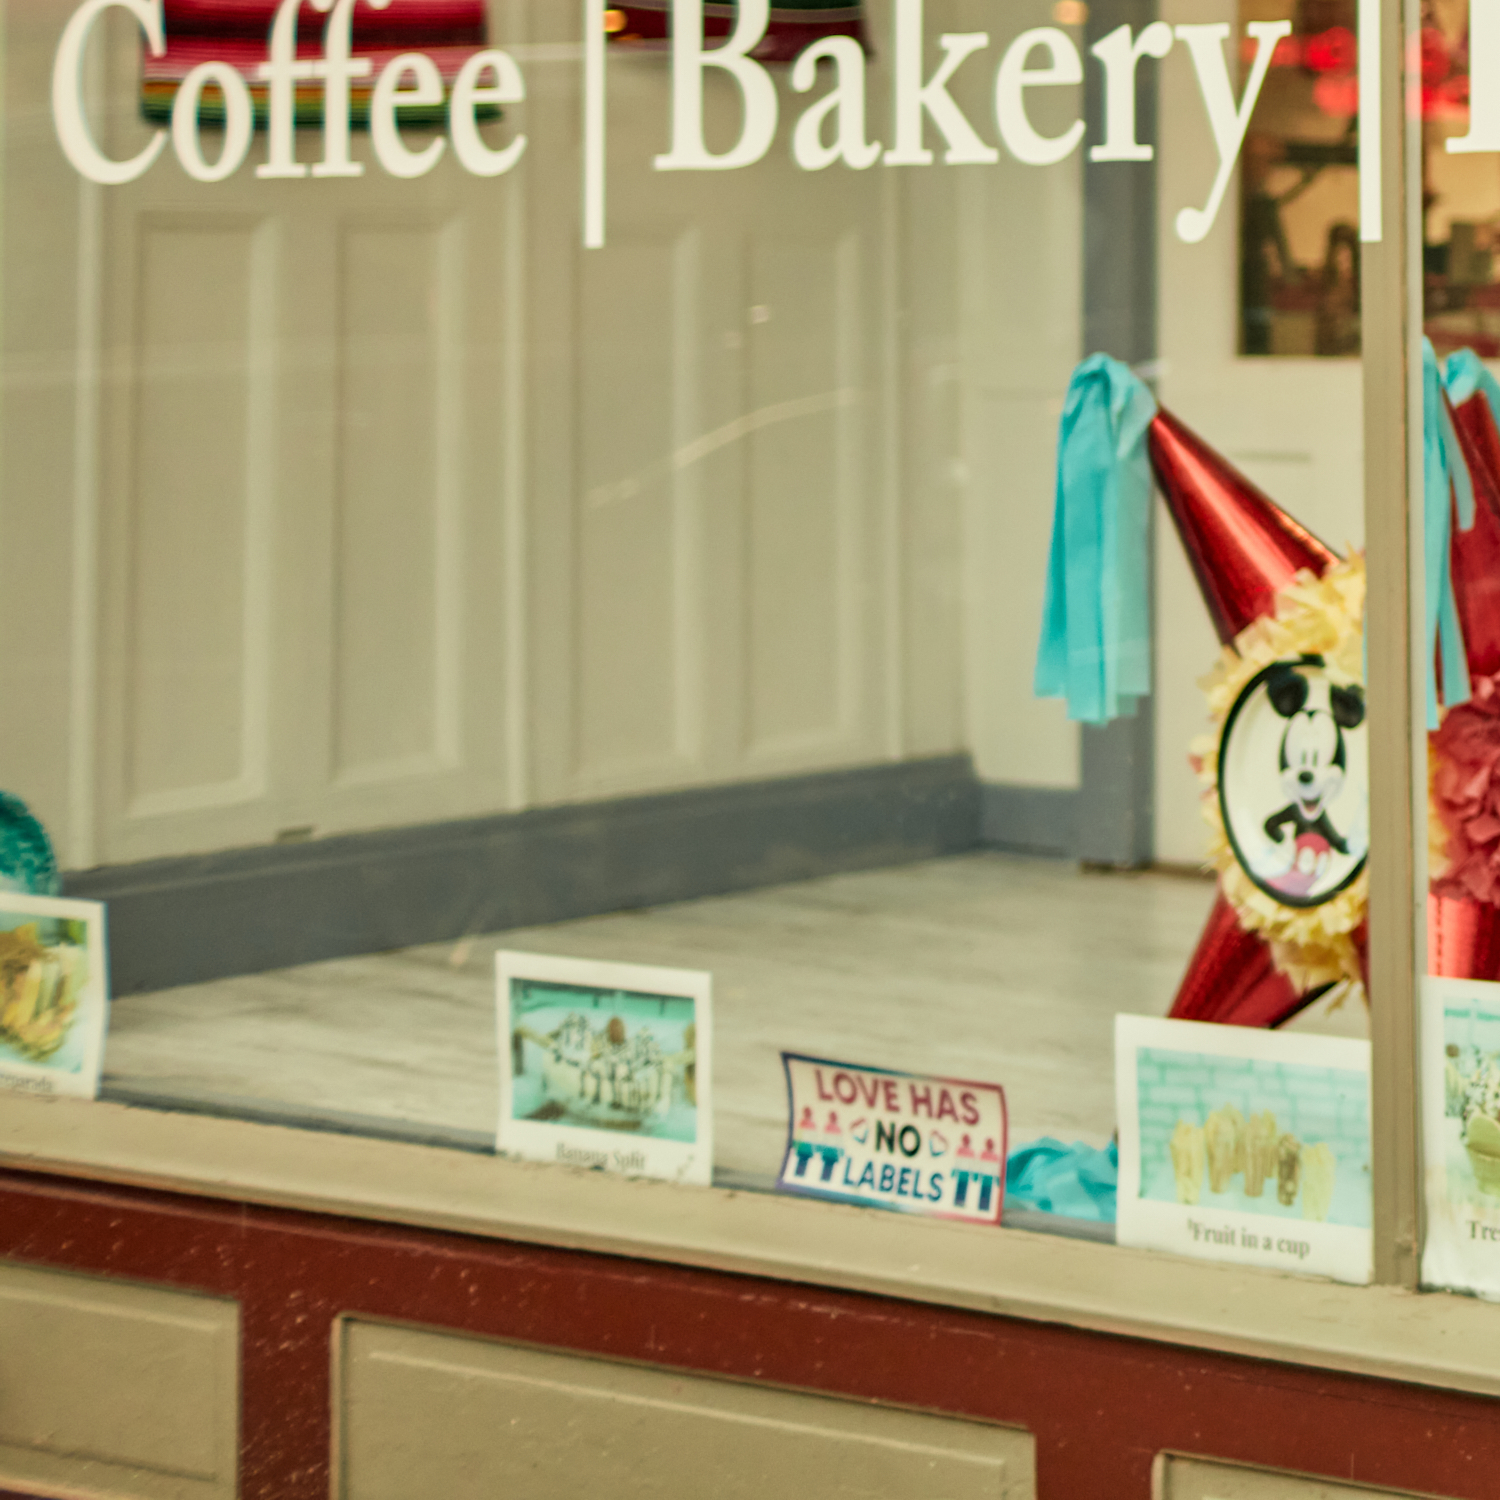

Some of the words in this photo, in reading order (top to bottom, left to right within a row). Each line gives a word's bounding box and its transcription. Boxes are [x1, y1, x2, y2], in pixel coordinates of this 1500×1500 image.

[815, 1067, 901, 1113] LOVE
[909, 1083, 980, 1126] HAS
[875, 1119, 921, 1157] NO
[843, 1156, 944, 1202] LABELS
[1188, 1219, 1235, 1246] Fruit
[1241, 1227, 1258, 1249] in
[1262, 1237, 1272, 1251] a
[1277, 1238, 1310, 1260] cup
